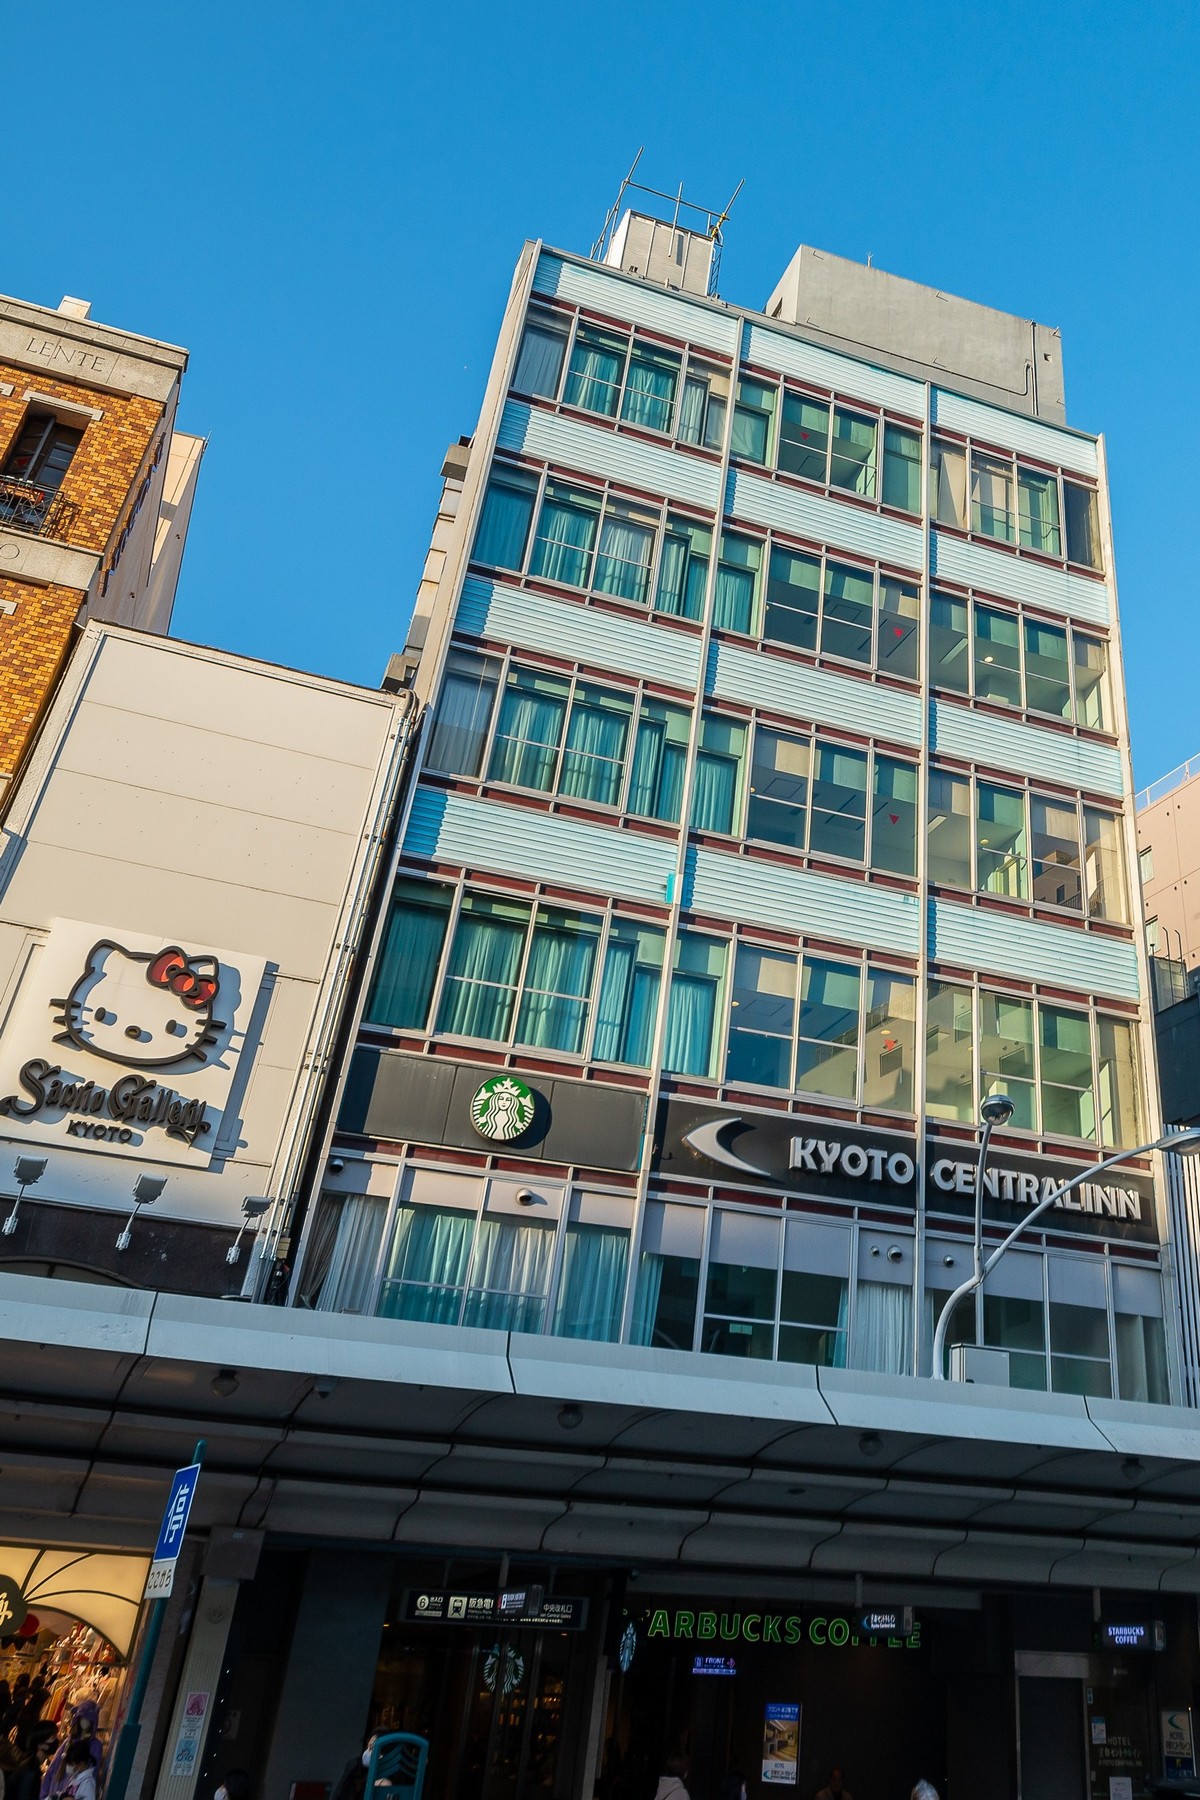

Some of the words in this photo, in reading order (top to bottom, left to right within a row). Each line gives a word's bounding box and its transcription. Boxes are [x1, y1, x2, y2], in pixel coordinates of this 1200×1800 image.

[26, 337, 105, 372] LENTE
[107, 1073, 212, 1150] Gallery
[65, 1118, 133, 1145] KYOTO
[789, 1135, 915, 1187] KYOTO
[163, 1483, 190, 1544] 停
[469, 1597, 494, 1609] 阪急電
[622, 1608, 801, 1644] ARBUCKS
[1108, 1625, 1144, 1636] STARBUCKS
[1115, 1635, 1138, 1645] COFFEE
[1107, 1736, 1131, 1746] HOTEL
